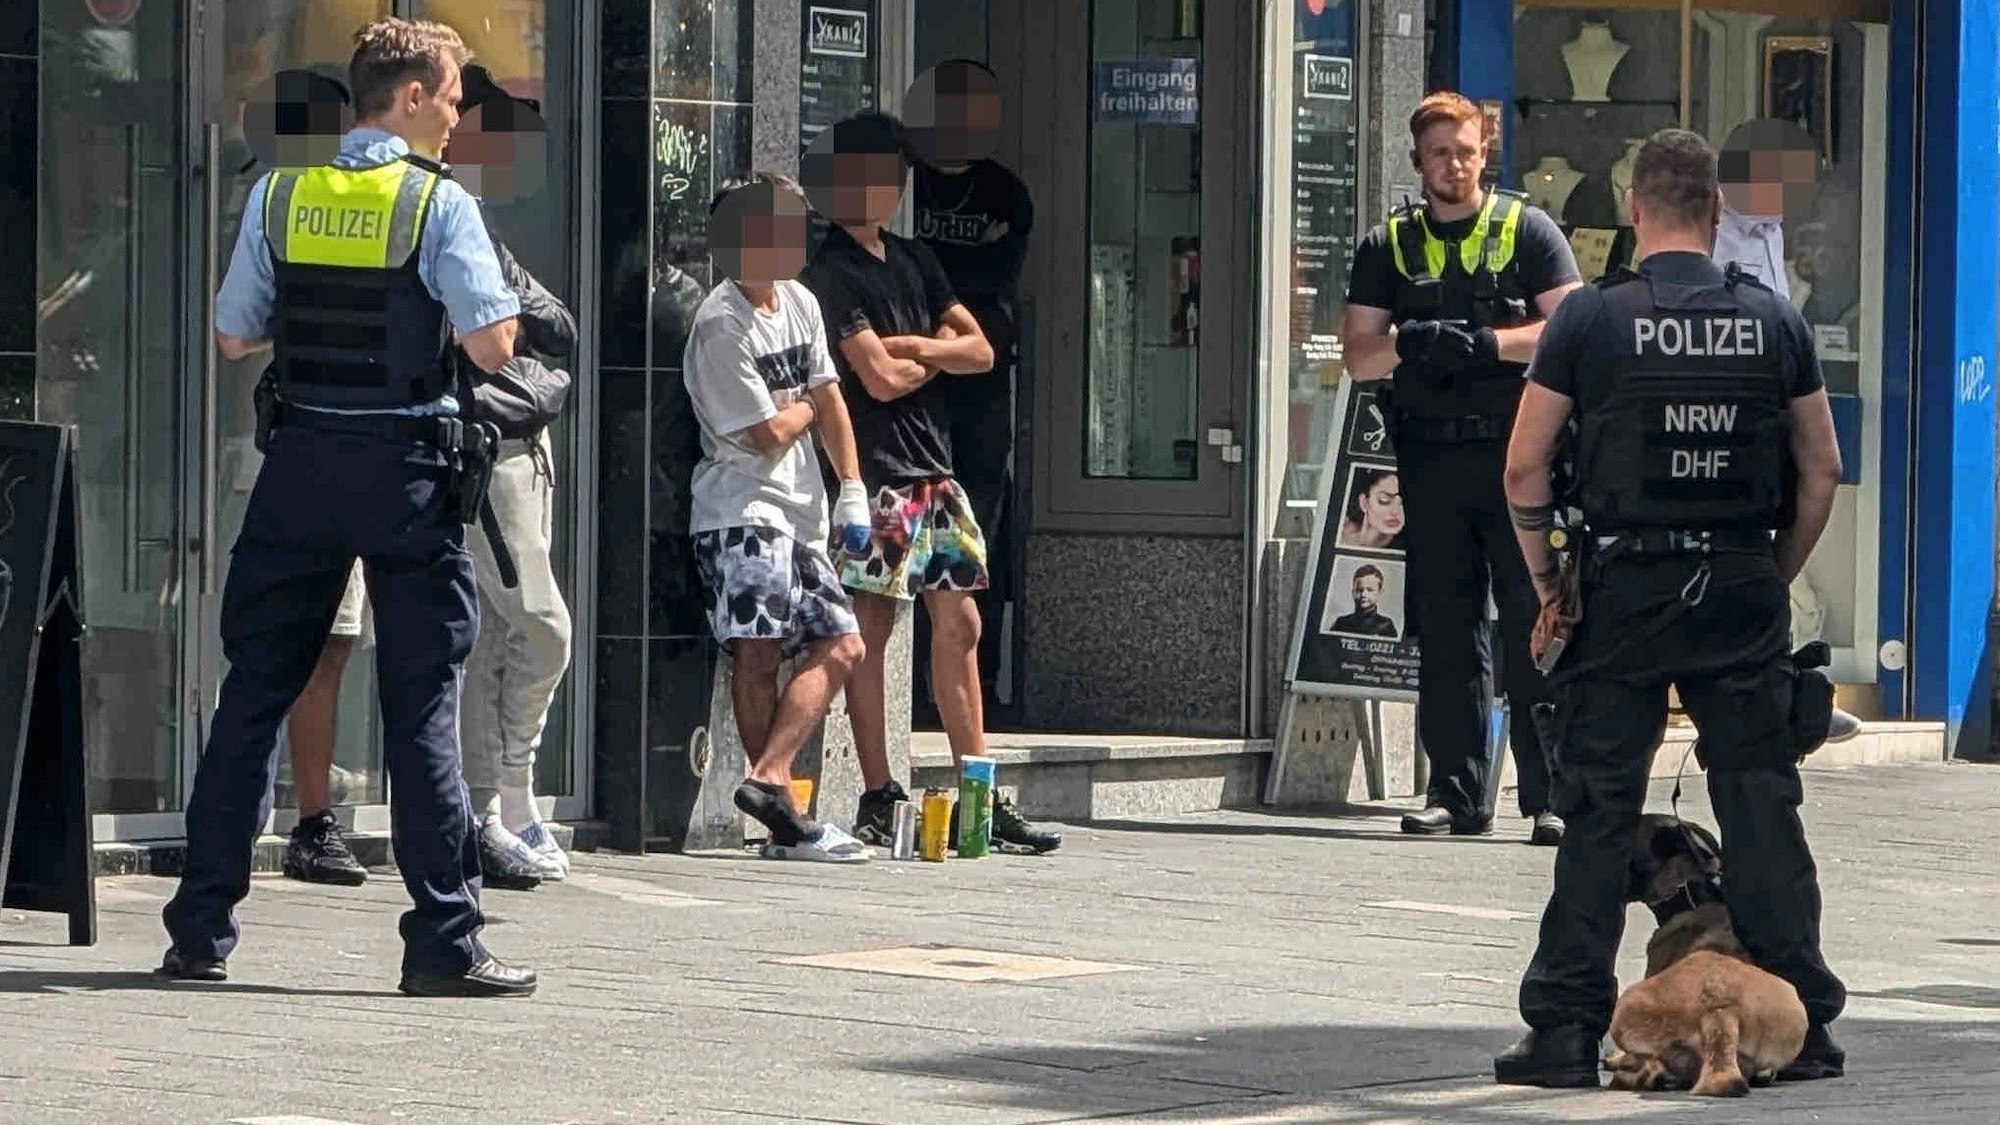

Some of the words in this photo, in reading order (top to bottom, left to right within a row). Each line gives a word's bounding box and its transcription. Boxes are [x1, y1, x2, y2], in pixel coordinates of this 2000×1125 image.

[1112, 67, 1196, 92] Eingang
[1100, 90, 1199, 112] freihalten
[294, 205, 384, 240] POLIZEI
[1634, 317, 1764, 356] POLIZEI
[1664, 404, 1738, 432] NRW
[1671, 450, 1731, 478] DHF
